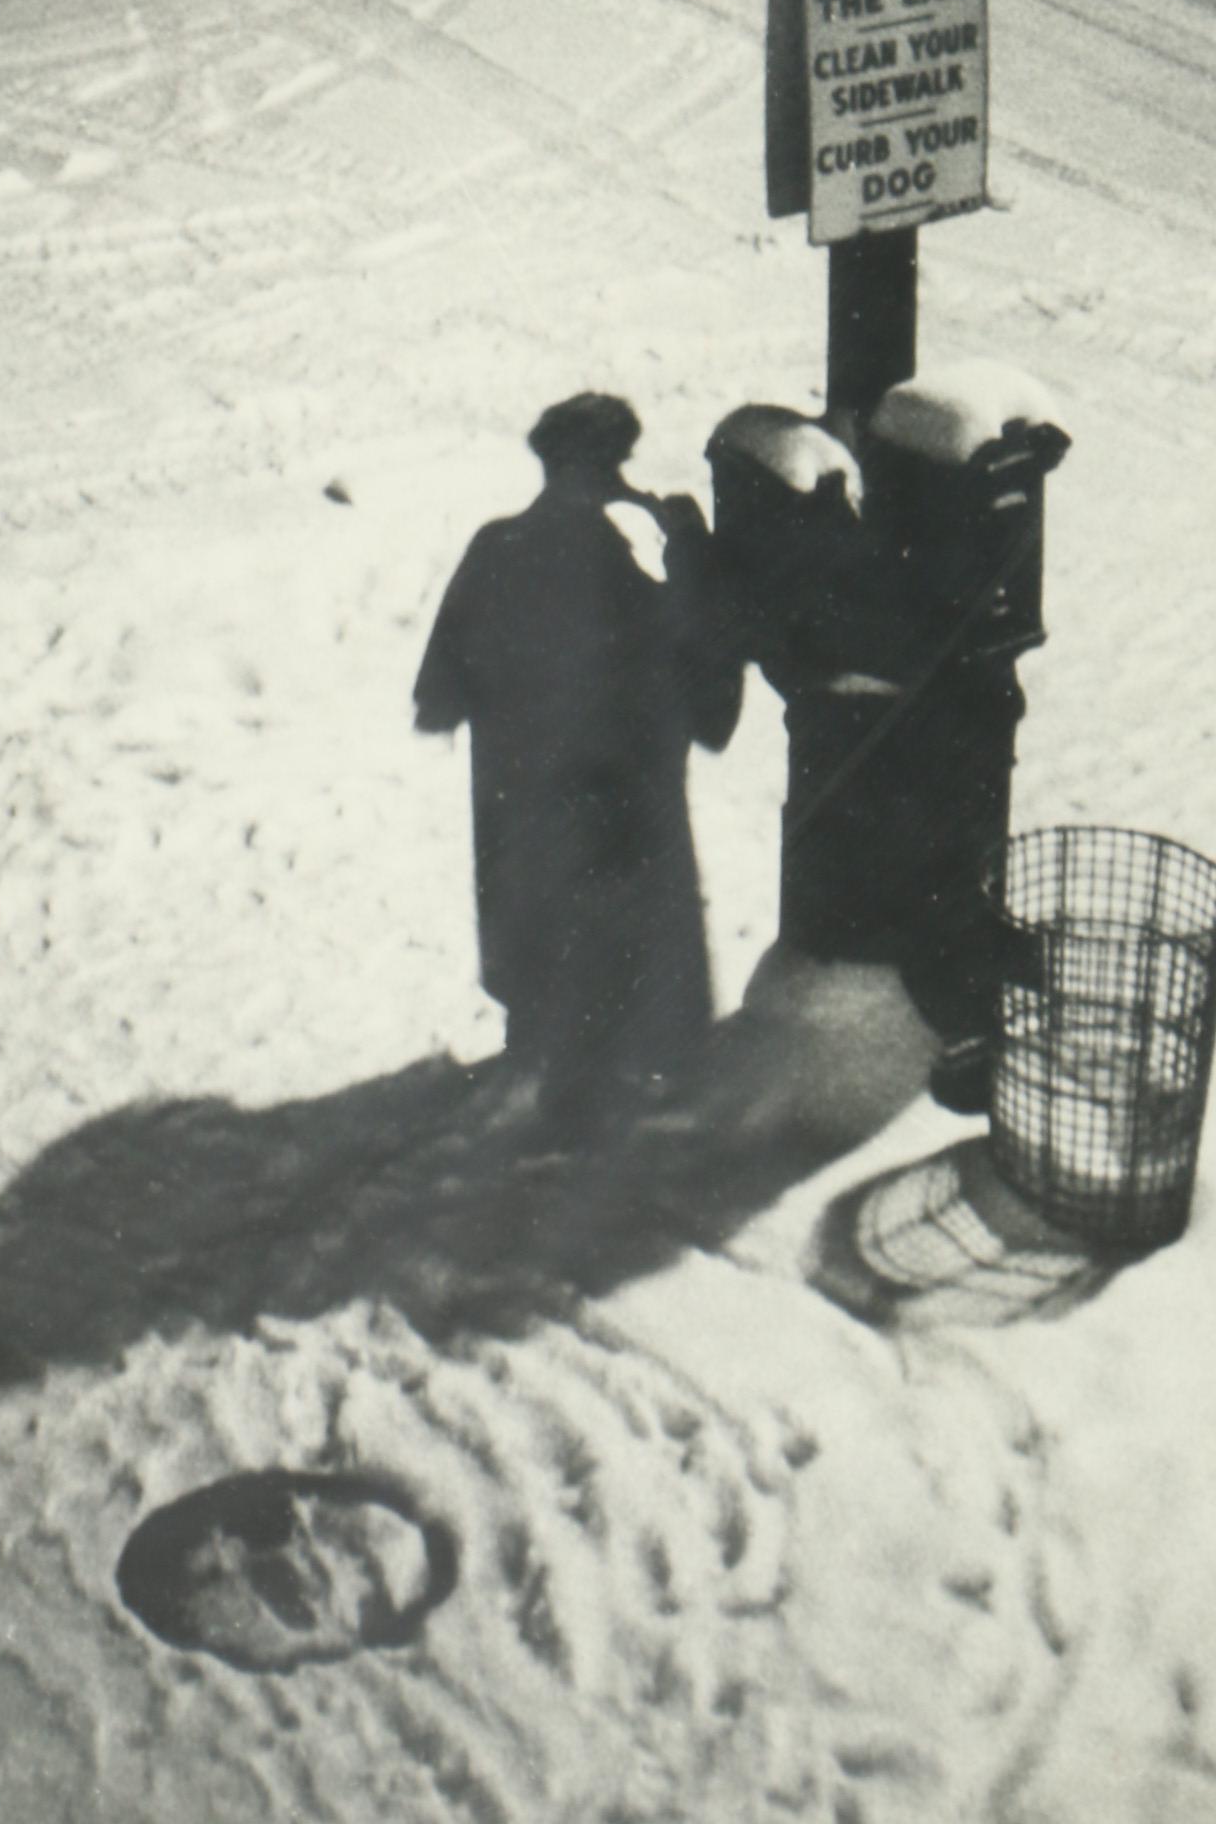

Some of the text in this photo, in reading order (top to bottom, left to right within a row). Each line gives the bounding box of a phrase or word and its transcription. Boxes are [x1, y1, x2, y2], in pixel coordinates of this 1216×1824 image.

[814, 23, 979, 81] CLEAN YOUR
[832, 64, 966, 117] SIDEWALK
[817, 116, 978, 176] CURB YOUR
[861, 161, 937, 204] DOG
